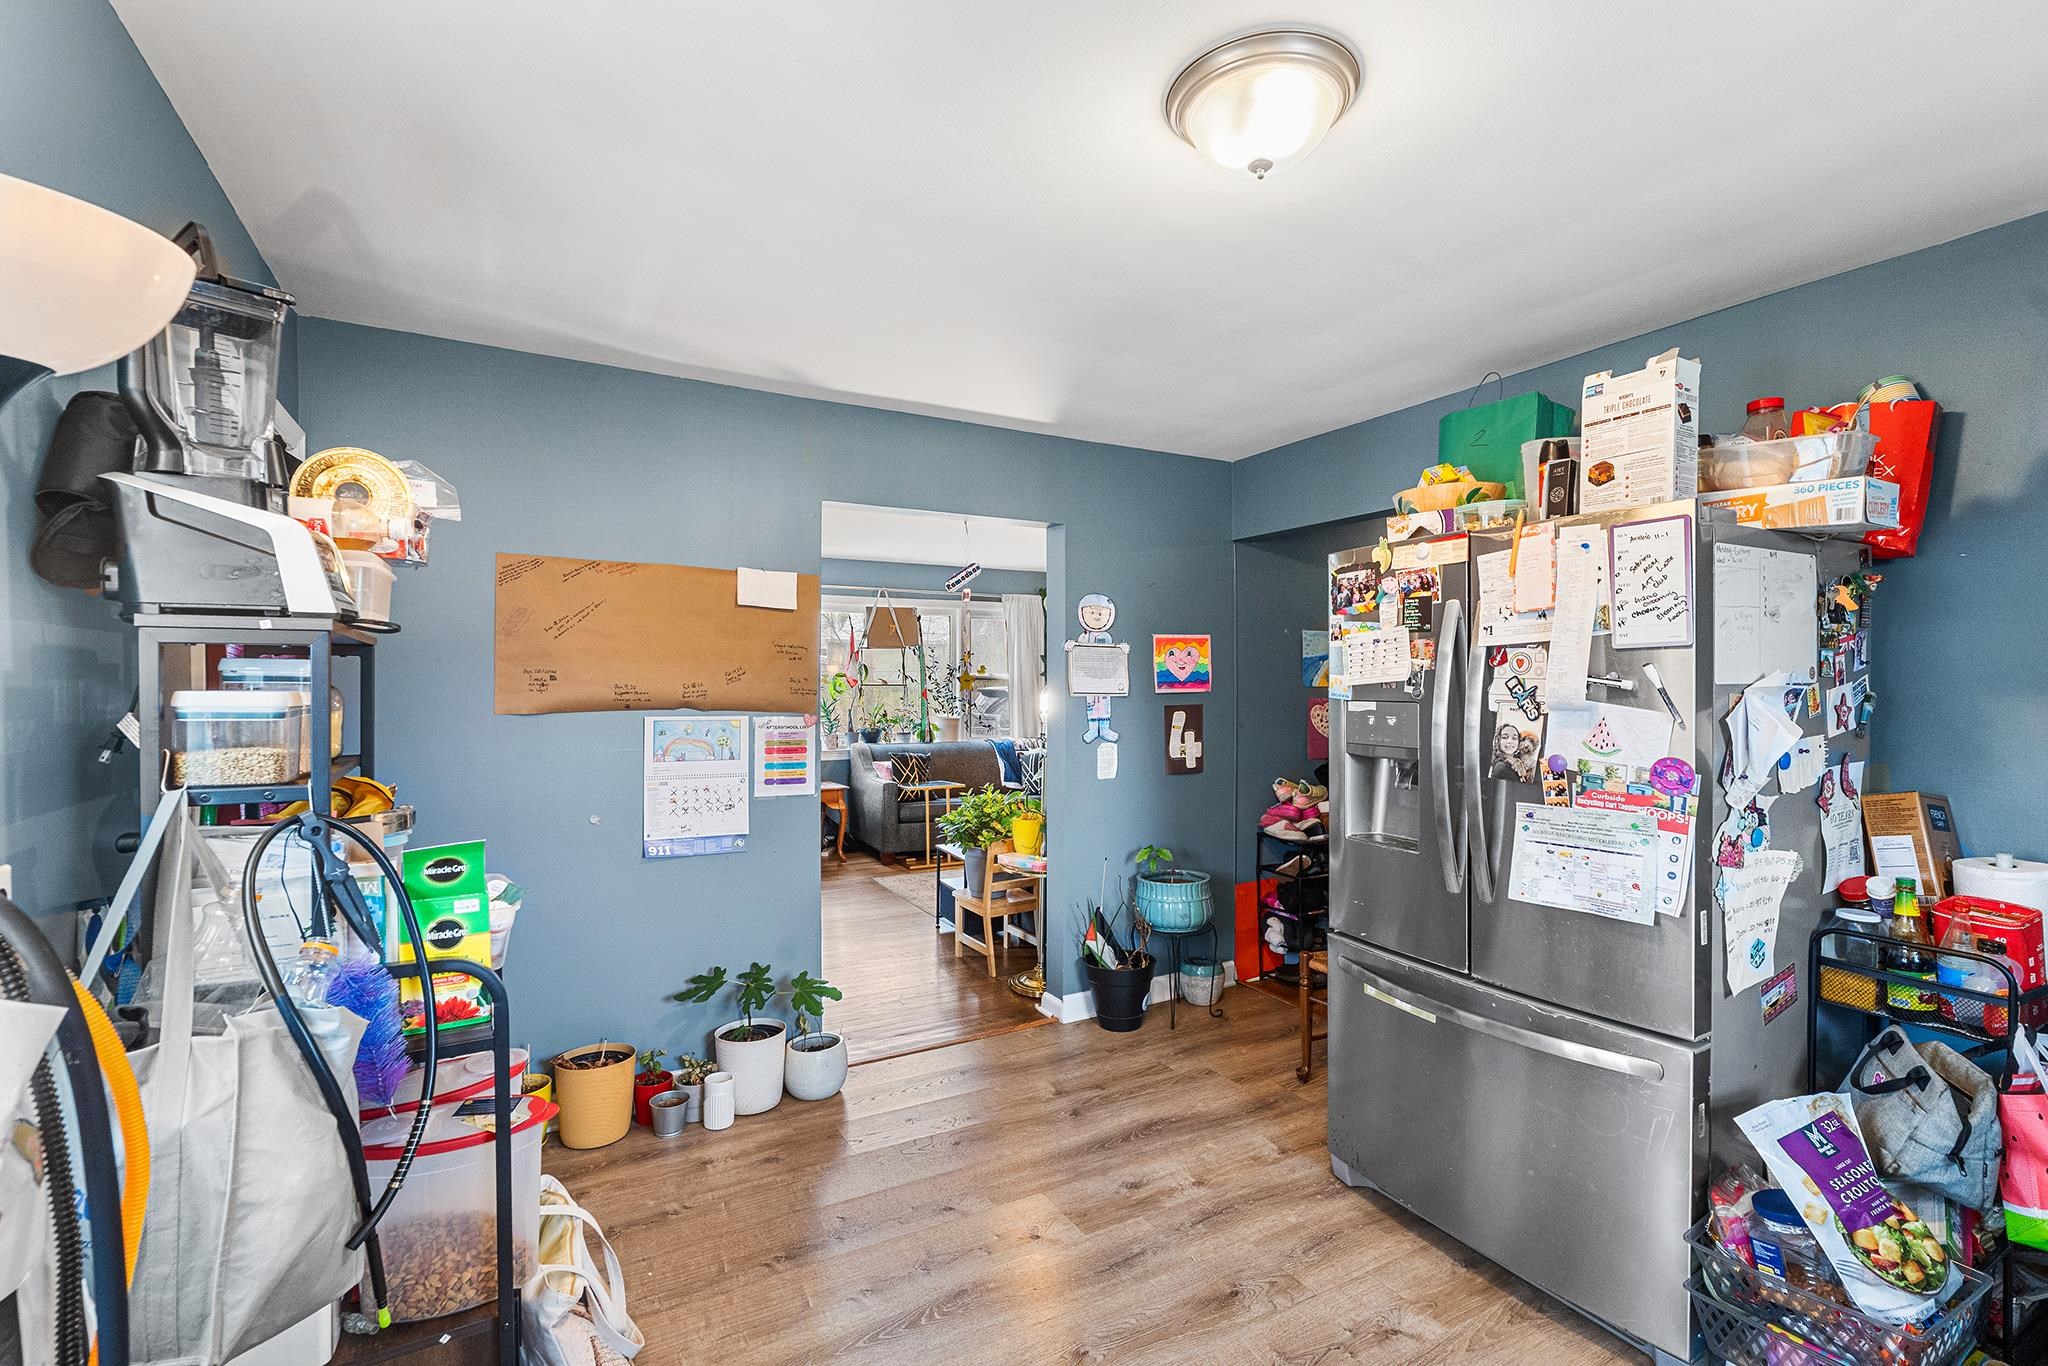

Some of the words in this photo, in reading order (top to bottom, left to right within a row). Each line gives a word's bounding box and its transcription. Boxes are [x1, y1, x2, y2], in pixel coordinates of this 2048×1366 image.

[1603, 403, 1620, 414] TRIPLE
[1621, 394, 1652, 410] CHOCOLATE
[1470, 429, 1489, 447] 2
[1793, 484, 1815, 494] 360
[1818, 480, 1860, 492] PIECES
[1630, 532, 1651, 543] Arabic
[1511, 684, 1540, 720] PARIS
[1577, 798, 1605, 808] Recycling
[1604, 801, 1617, 809] Cart
[1591, 792, 1626, 803] Curbside
[648, 845, 672, 856] 911
